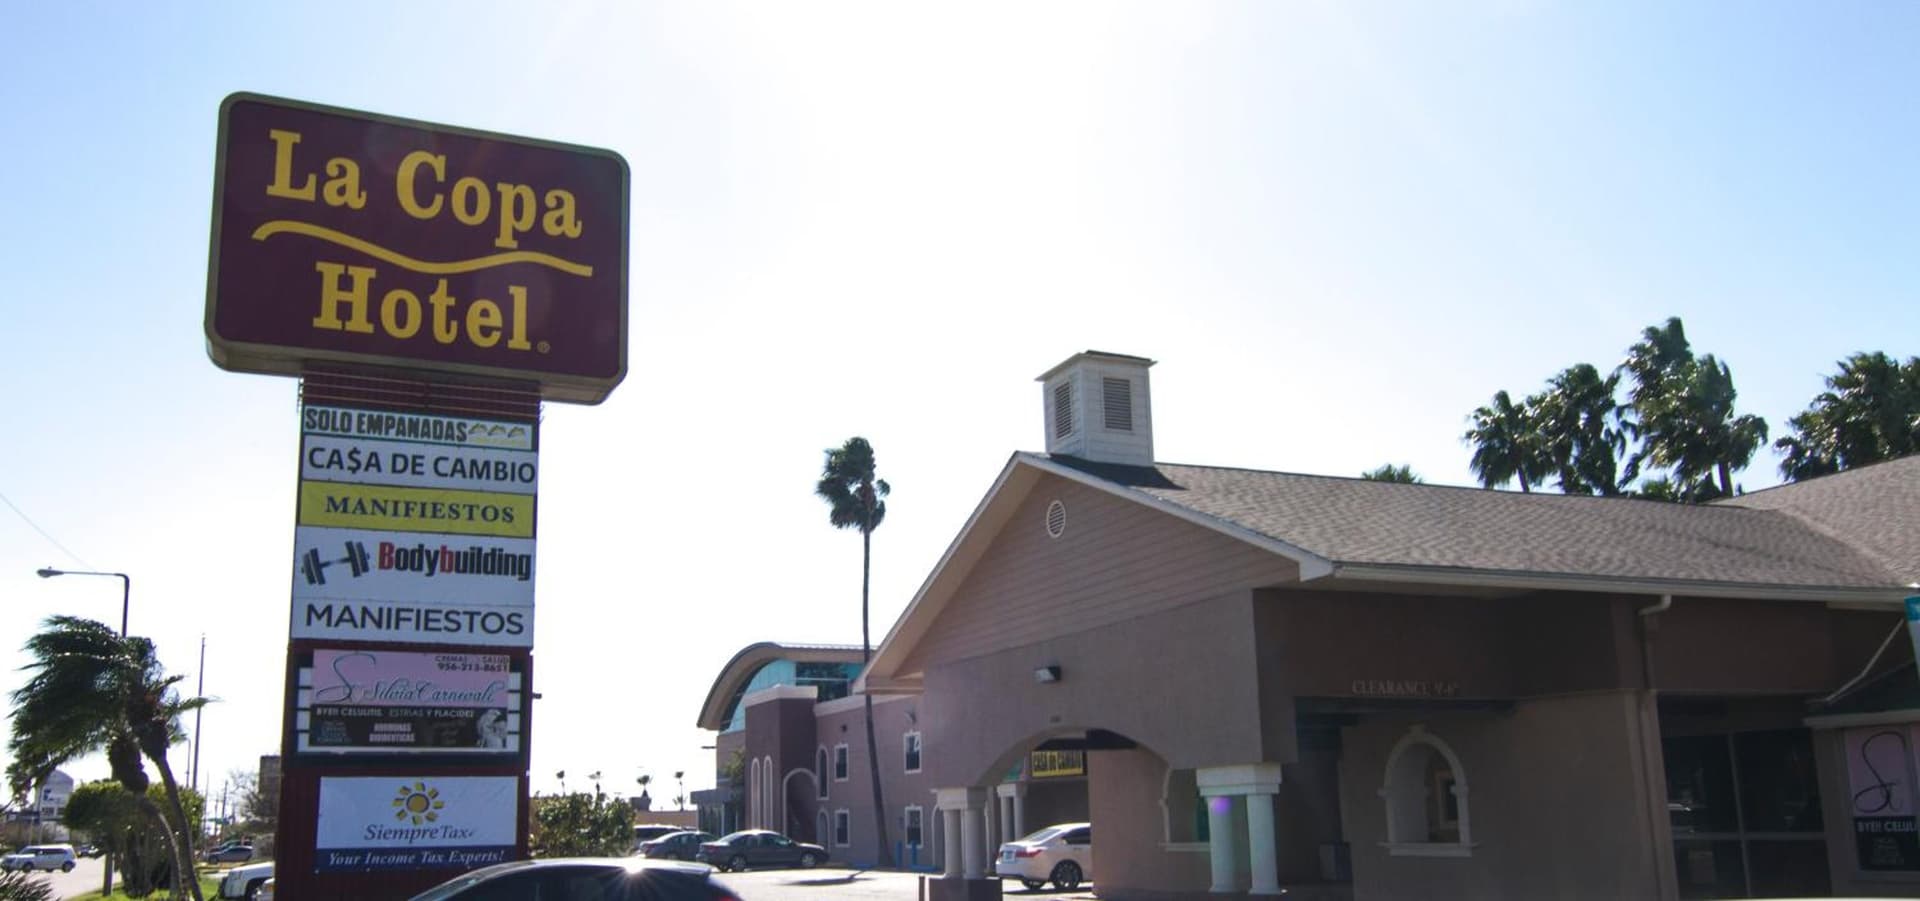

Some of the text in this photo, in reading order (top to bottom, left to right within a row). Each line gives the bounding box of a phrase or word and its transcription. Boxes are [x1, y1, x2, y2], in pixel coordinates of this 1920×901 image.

[266, 129, 582, 249] La Copa
[313, 261, 532, 351] Hotel
[305, 408, 467, 442] SOLO EMPANADAS
[391, 453, 425, 475] DE
[433, 456, 536, 483] CAMBIO
[325, 496, 514, 523] MANIFIESTOS
[379, 541, 531, 581] Bodybuilding
[306, 604, 524, 635] MANIFIESTOS
[1352, 679, 1427, 695] CLEARANCE
[329, 850, 504, 865] Your Income Tax Experts!
